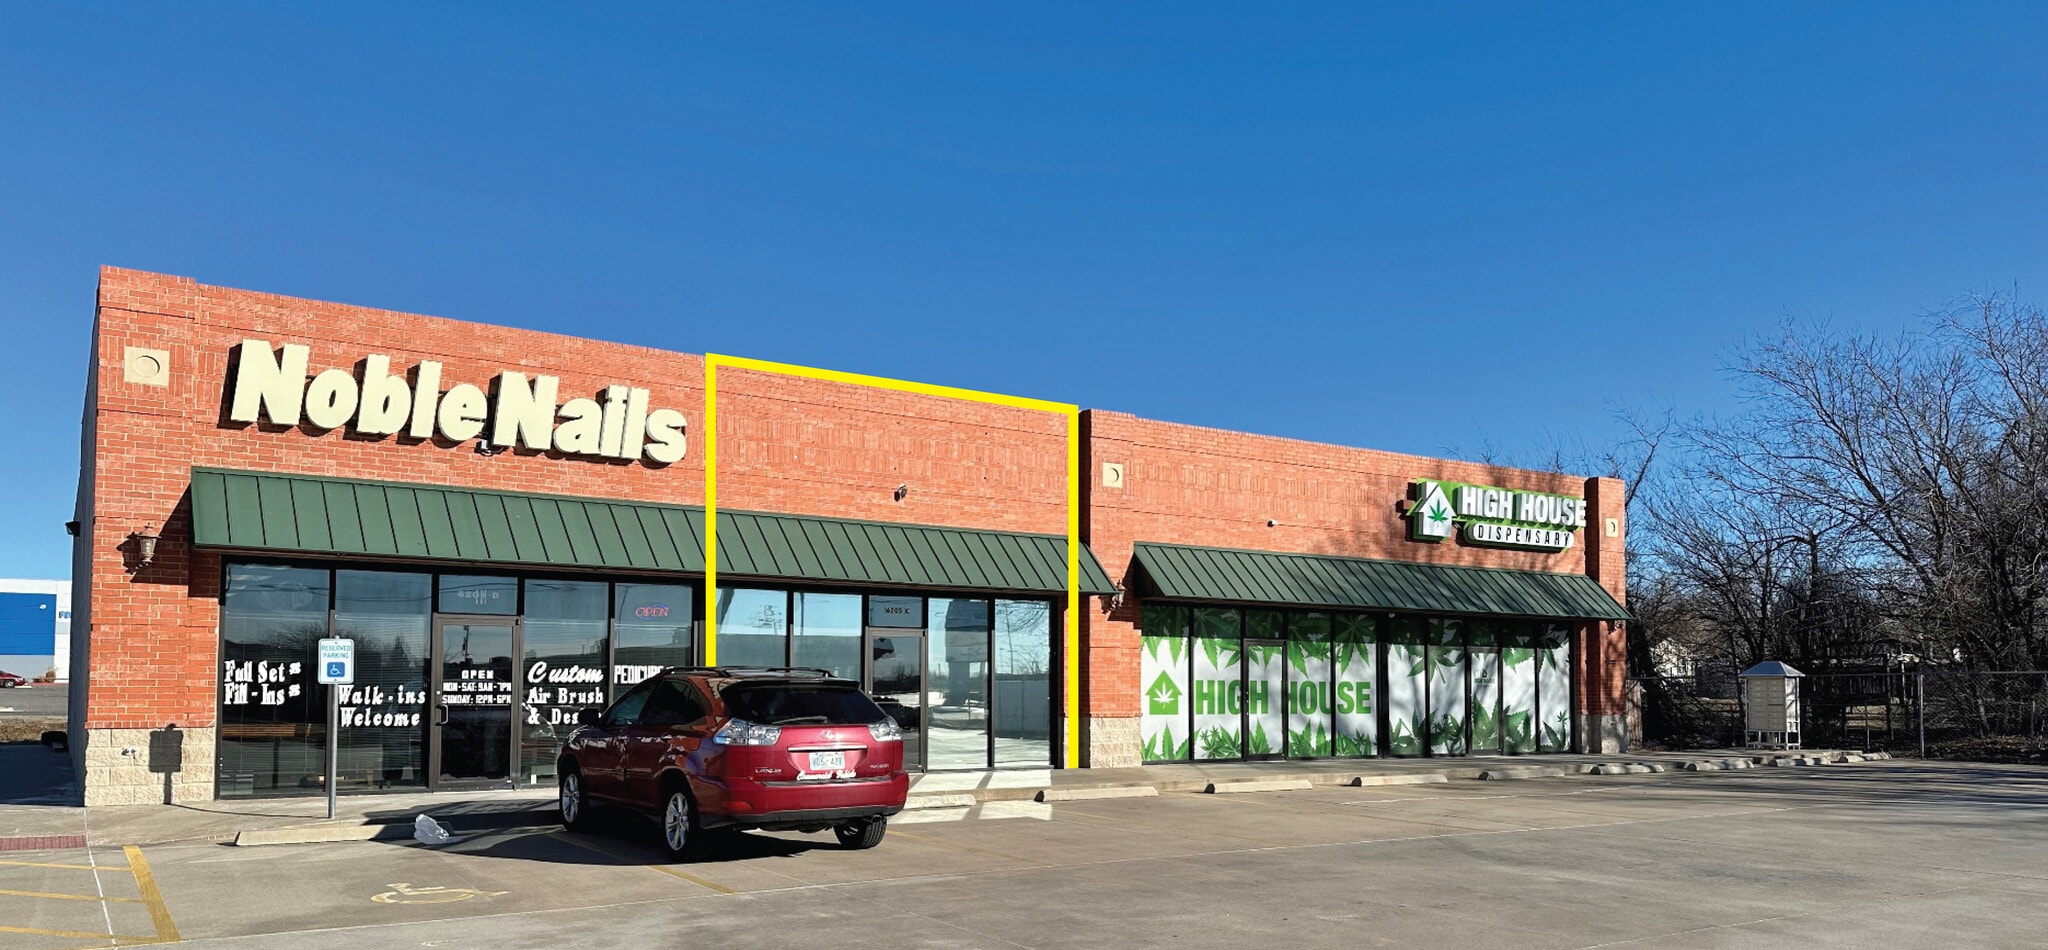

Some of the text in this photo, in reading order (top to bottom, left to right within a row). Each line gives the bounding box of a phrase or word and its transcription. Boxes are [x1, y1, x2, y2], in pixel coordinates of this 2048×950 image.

[230, 339, 687, 464] Noble Nails
[1460, 486, 1587, 527] HIGH HOUSE
[1477, 524, 1570, 547] DISPENSARY
[635, 606, 670, 617] OPEN
[224, 660, 253, 683] Full
[258, 660, 285, 683] Set
[461, 670, 494, 679] OPEN
[527, 661, 604, 683] Custom
[527, 686, 604, 704] Air Brush
[1195, 679, 1269, 715] HIGH
[340, 706, 421, 727] Welcome
[527, 707, 541, 725] &
